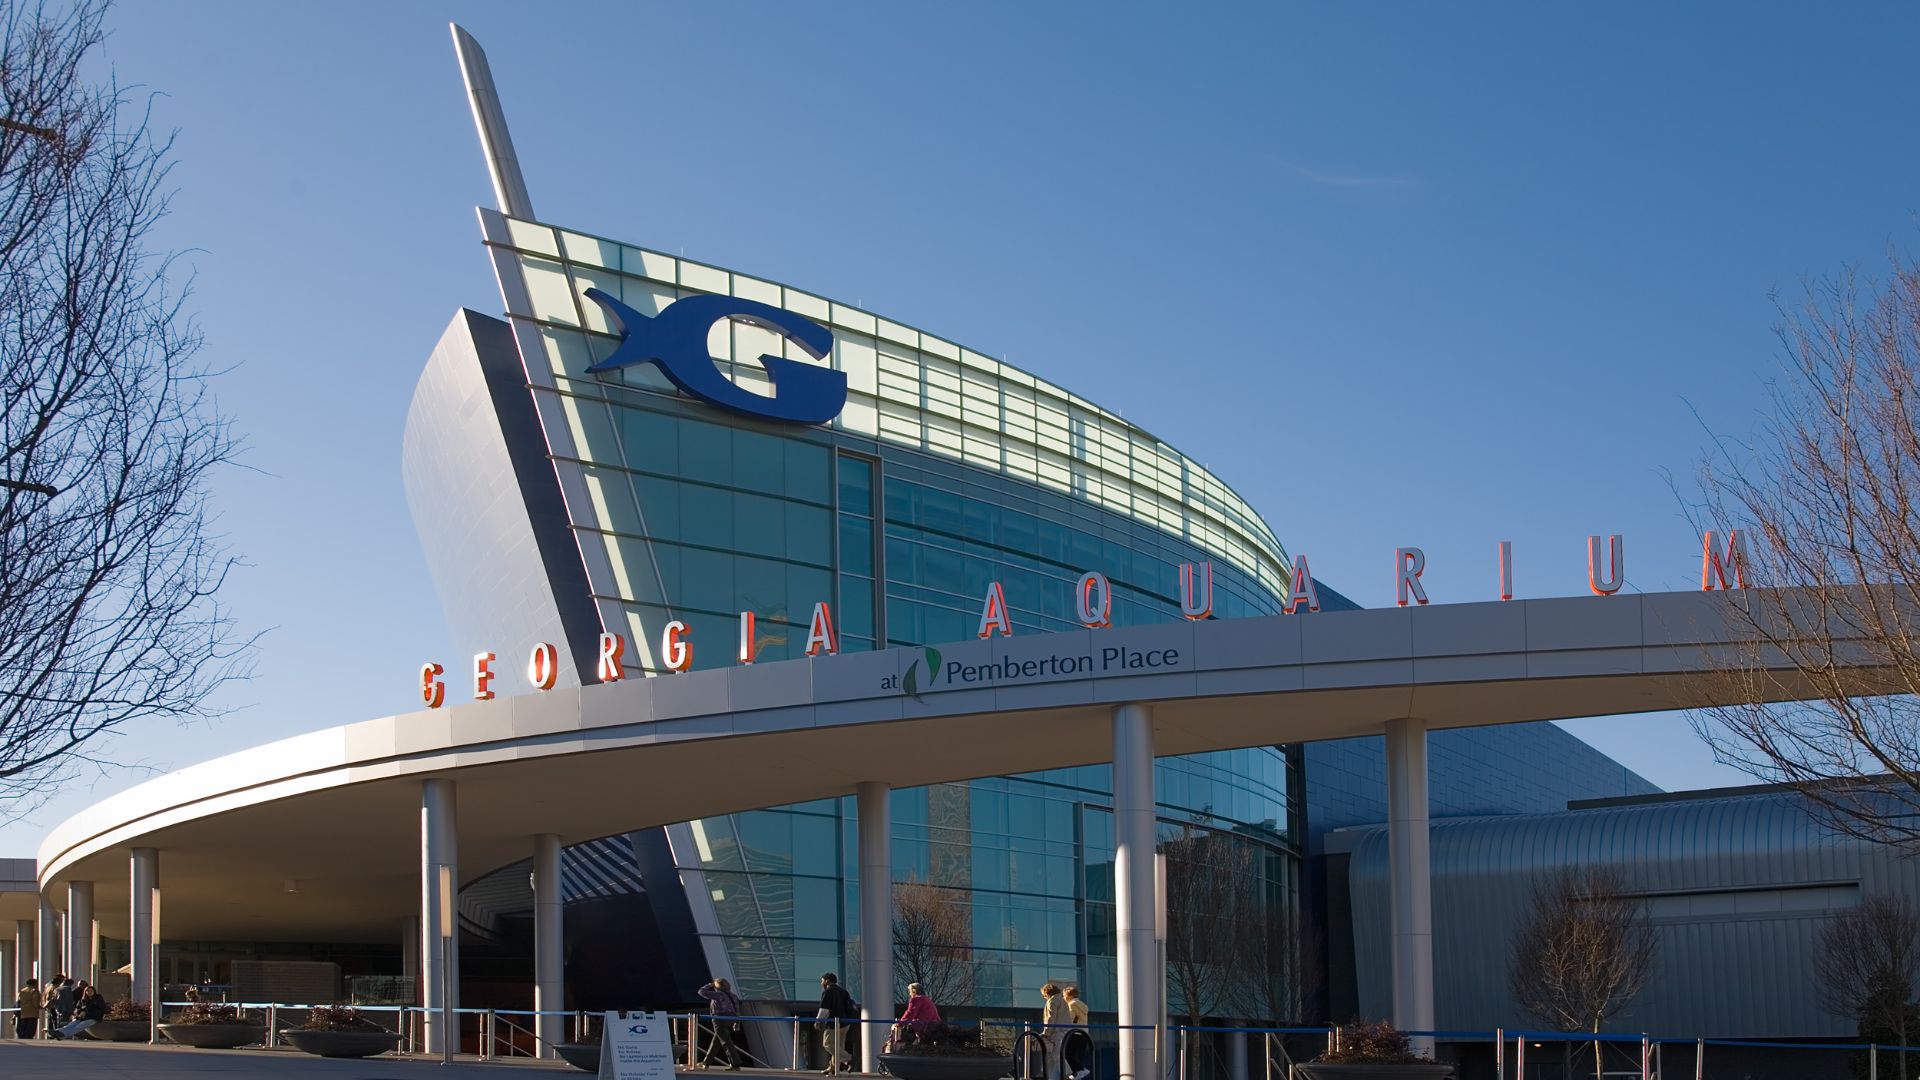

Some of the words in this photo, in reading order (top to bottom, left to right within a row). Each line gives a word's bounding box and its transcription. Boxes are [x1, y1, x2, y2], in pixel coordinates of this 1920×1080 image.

[419, 601, 838, 709] GEORGIA
[977, 529, 1752, 639] AQUARIUM
[880, 674, 898, 690] at
[946, 655, 1093, 684] Pemberton
[1102, 646, 1179, 670] Place
